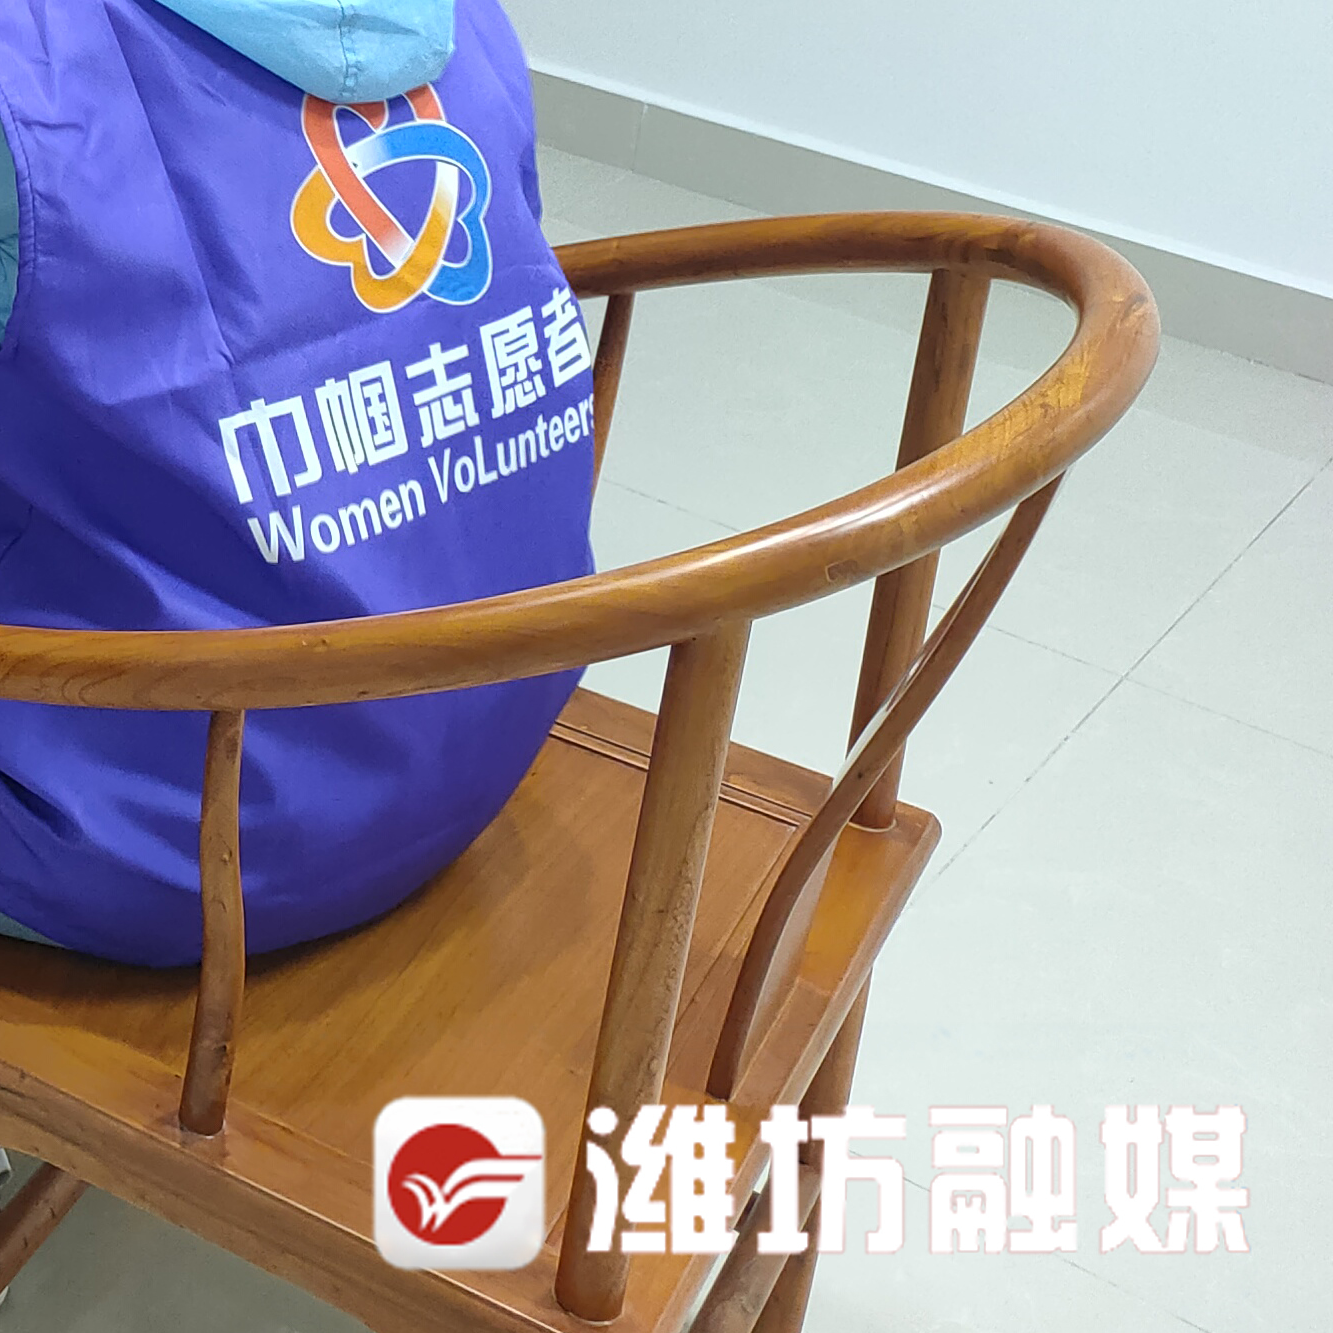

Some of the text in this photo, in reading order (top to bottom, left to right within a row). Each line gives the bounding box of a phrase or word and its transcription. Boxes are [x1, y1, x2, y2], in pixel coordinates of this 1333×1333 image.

[218, 286, 592, 505] 巾帼志愿者
[246, 478, 427, 564] Women
